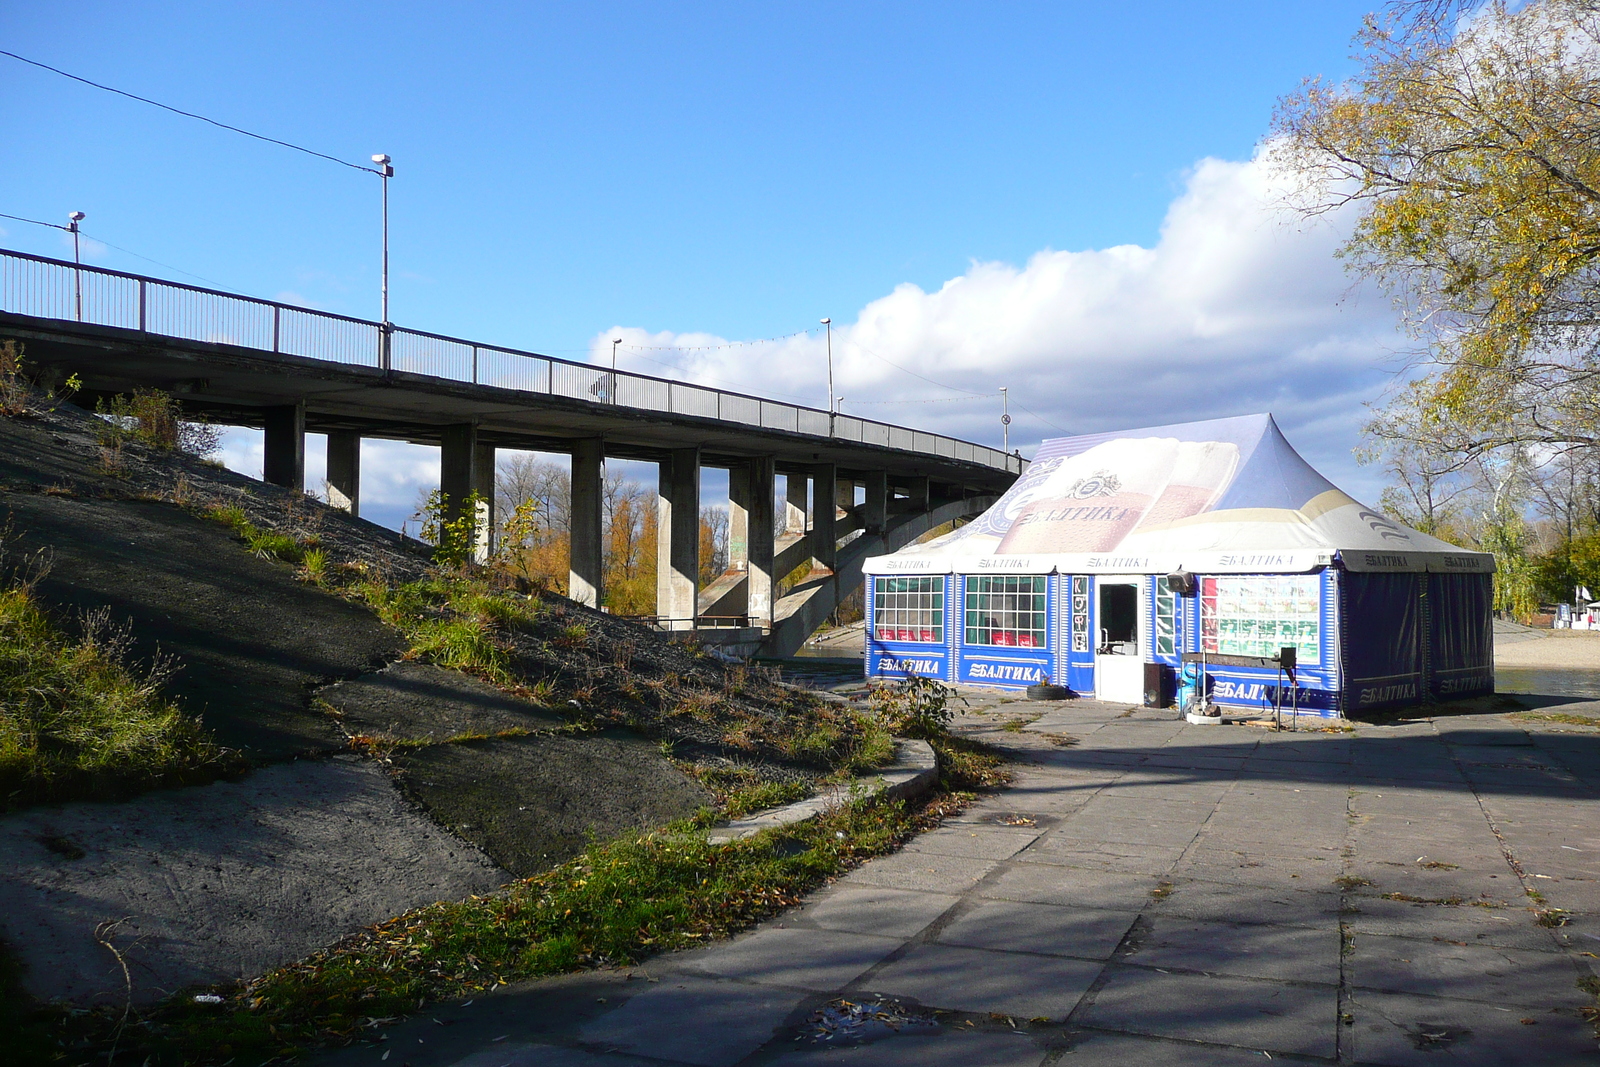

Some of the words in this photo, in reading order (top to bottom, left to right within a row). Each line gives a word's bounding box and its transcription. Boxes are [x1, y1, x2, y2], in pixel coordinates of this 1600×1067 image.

[1028, 506, 1129, 523] БАЛТИКА
[892, 560, 932, 569] БАЛТИКА
[985, 558, 1030, 568] БАЛТИКА
[1095, 558, 1149, 568] БАЛТИКА
[1229, 555, 1294, 566] БАЛТИКА
[1371, 555, 1408, 567] БАЛТИКА
[1450, 556, 1480, 568] БАЛТИКА
[886, 658, 939, 674] БАЛТИКА
[979, 663, 1041, 682] БАЛТИКА
[1369, 683, 1416, 703] БАЛТИКА
